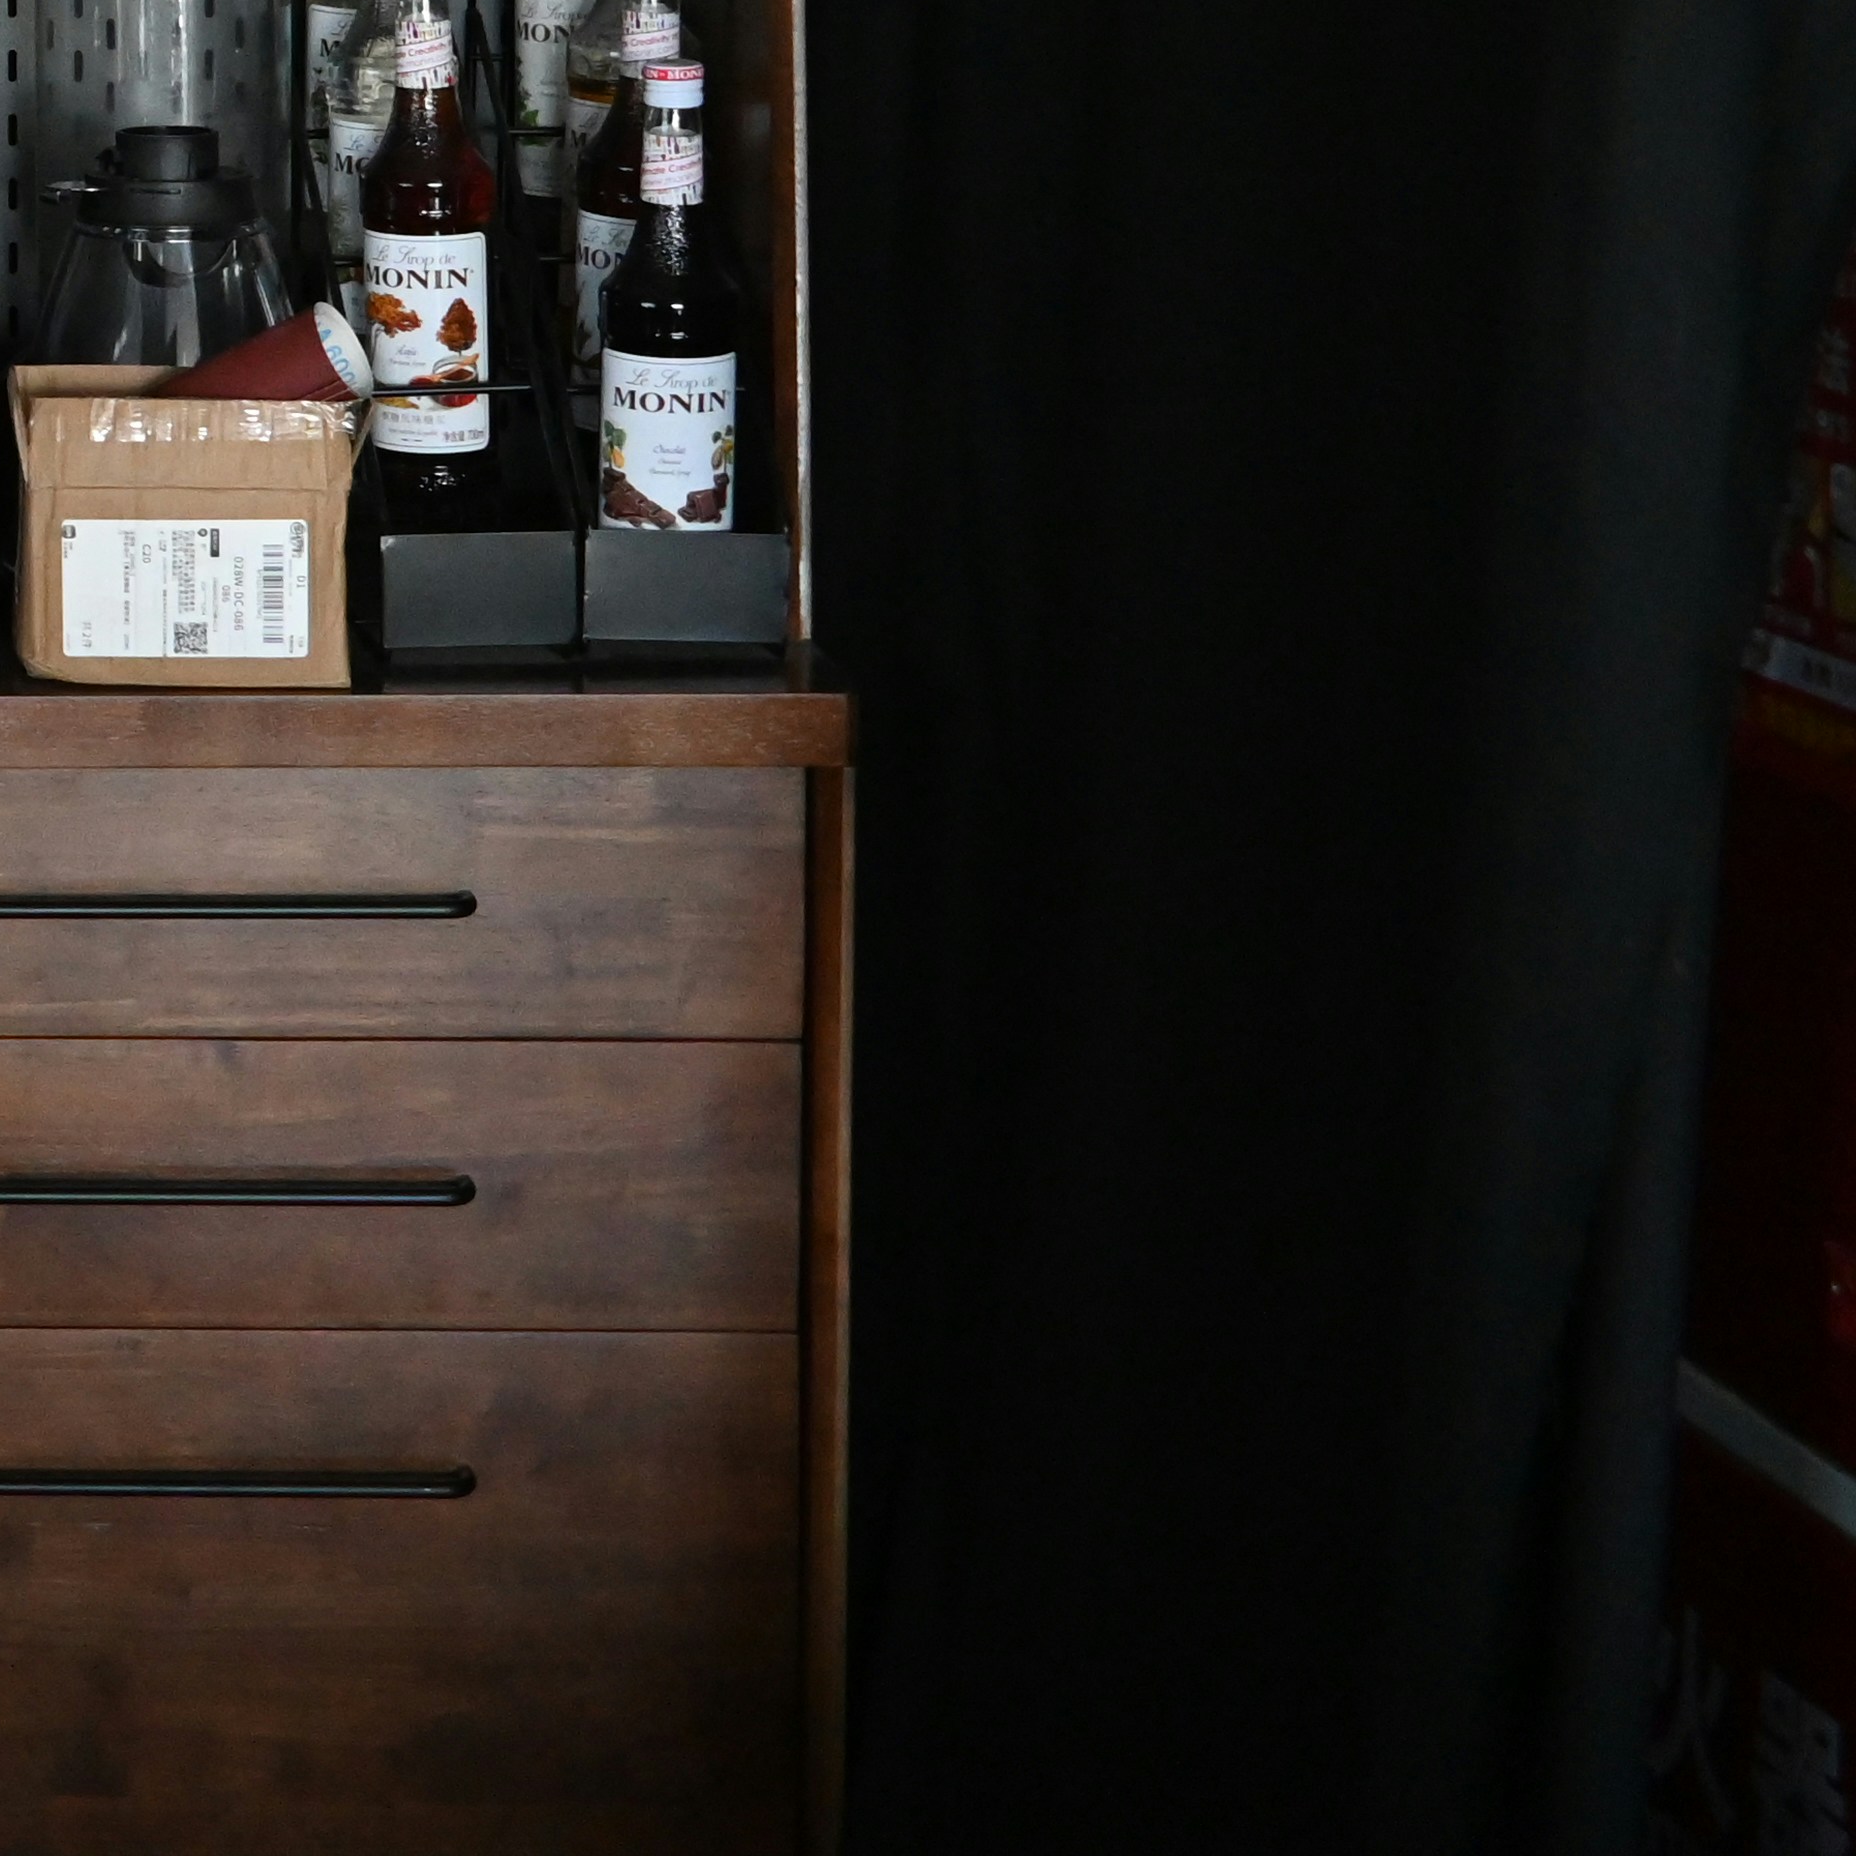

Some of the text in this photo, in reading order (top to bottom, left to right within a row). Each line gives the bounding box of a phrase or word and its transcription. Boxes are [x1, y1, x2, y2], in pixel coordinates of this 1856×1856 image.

[516, 19, 572, 44] MON
[366, 265, 469, 289] MONIN
[654, 368, 699, 393] Sirop
[613, 386, 727, 414] MONIN
